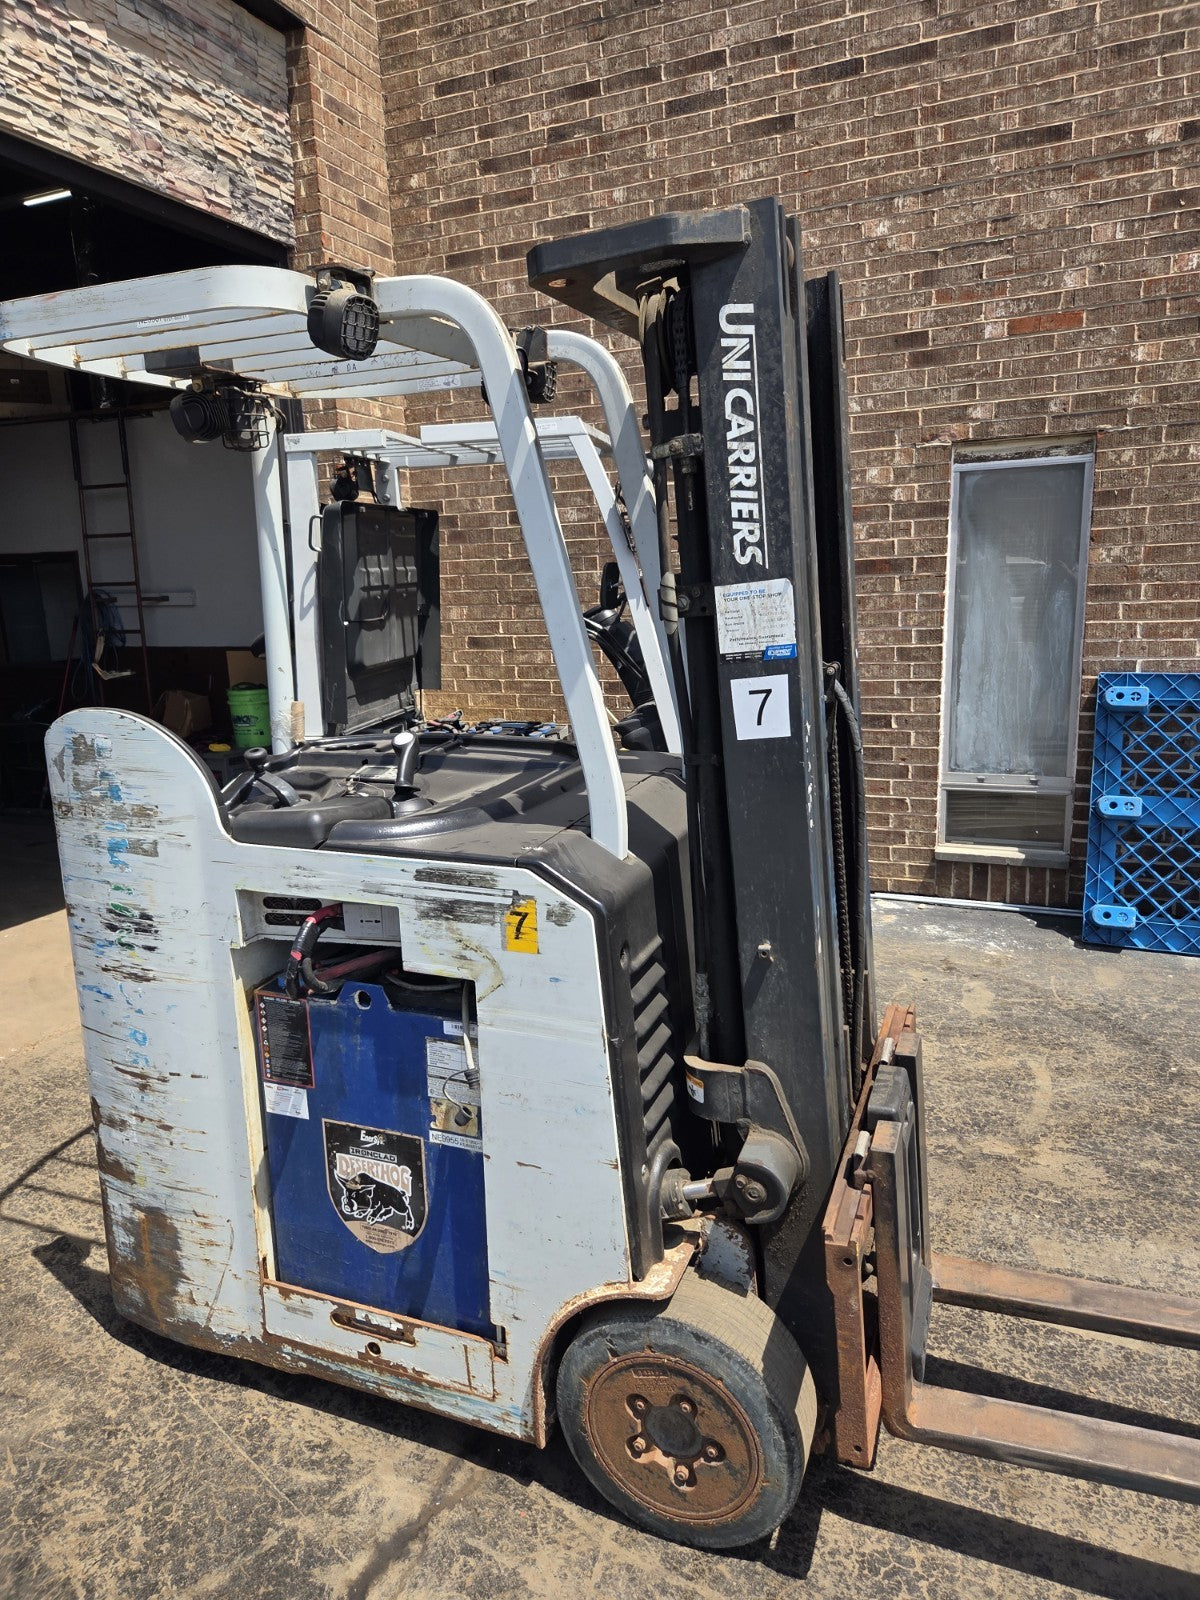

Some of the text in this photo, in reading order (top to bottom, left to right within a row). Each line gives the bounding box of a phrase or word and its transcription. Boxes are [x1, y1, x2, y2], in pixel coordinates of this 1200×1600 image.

[719, 303, 763, 566] UNICARRIERS
[722, 590, 749, 598] EQUIPPED
[748, 688, 773, 726] 7
[510, 911, 529, 940] 7
[350, 1148, 396, 1162] IRONCLAD
[336, 1153, 412, 1197] DESERTHOG
